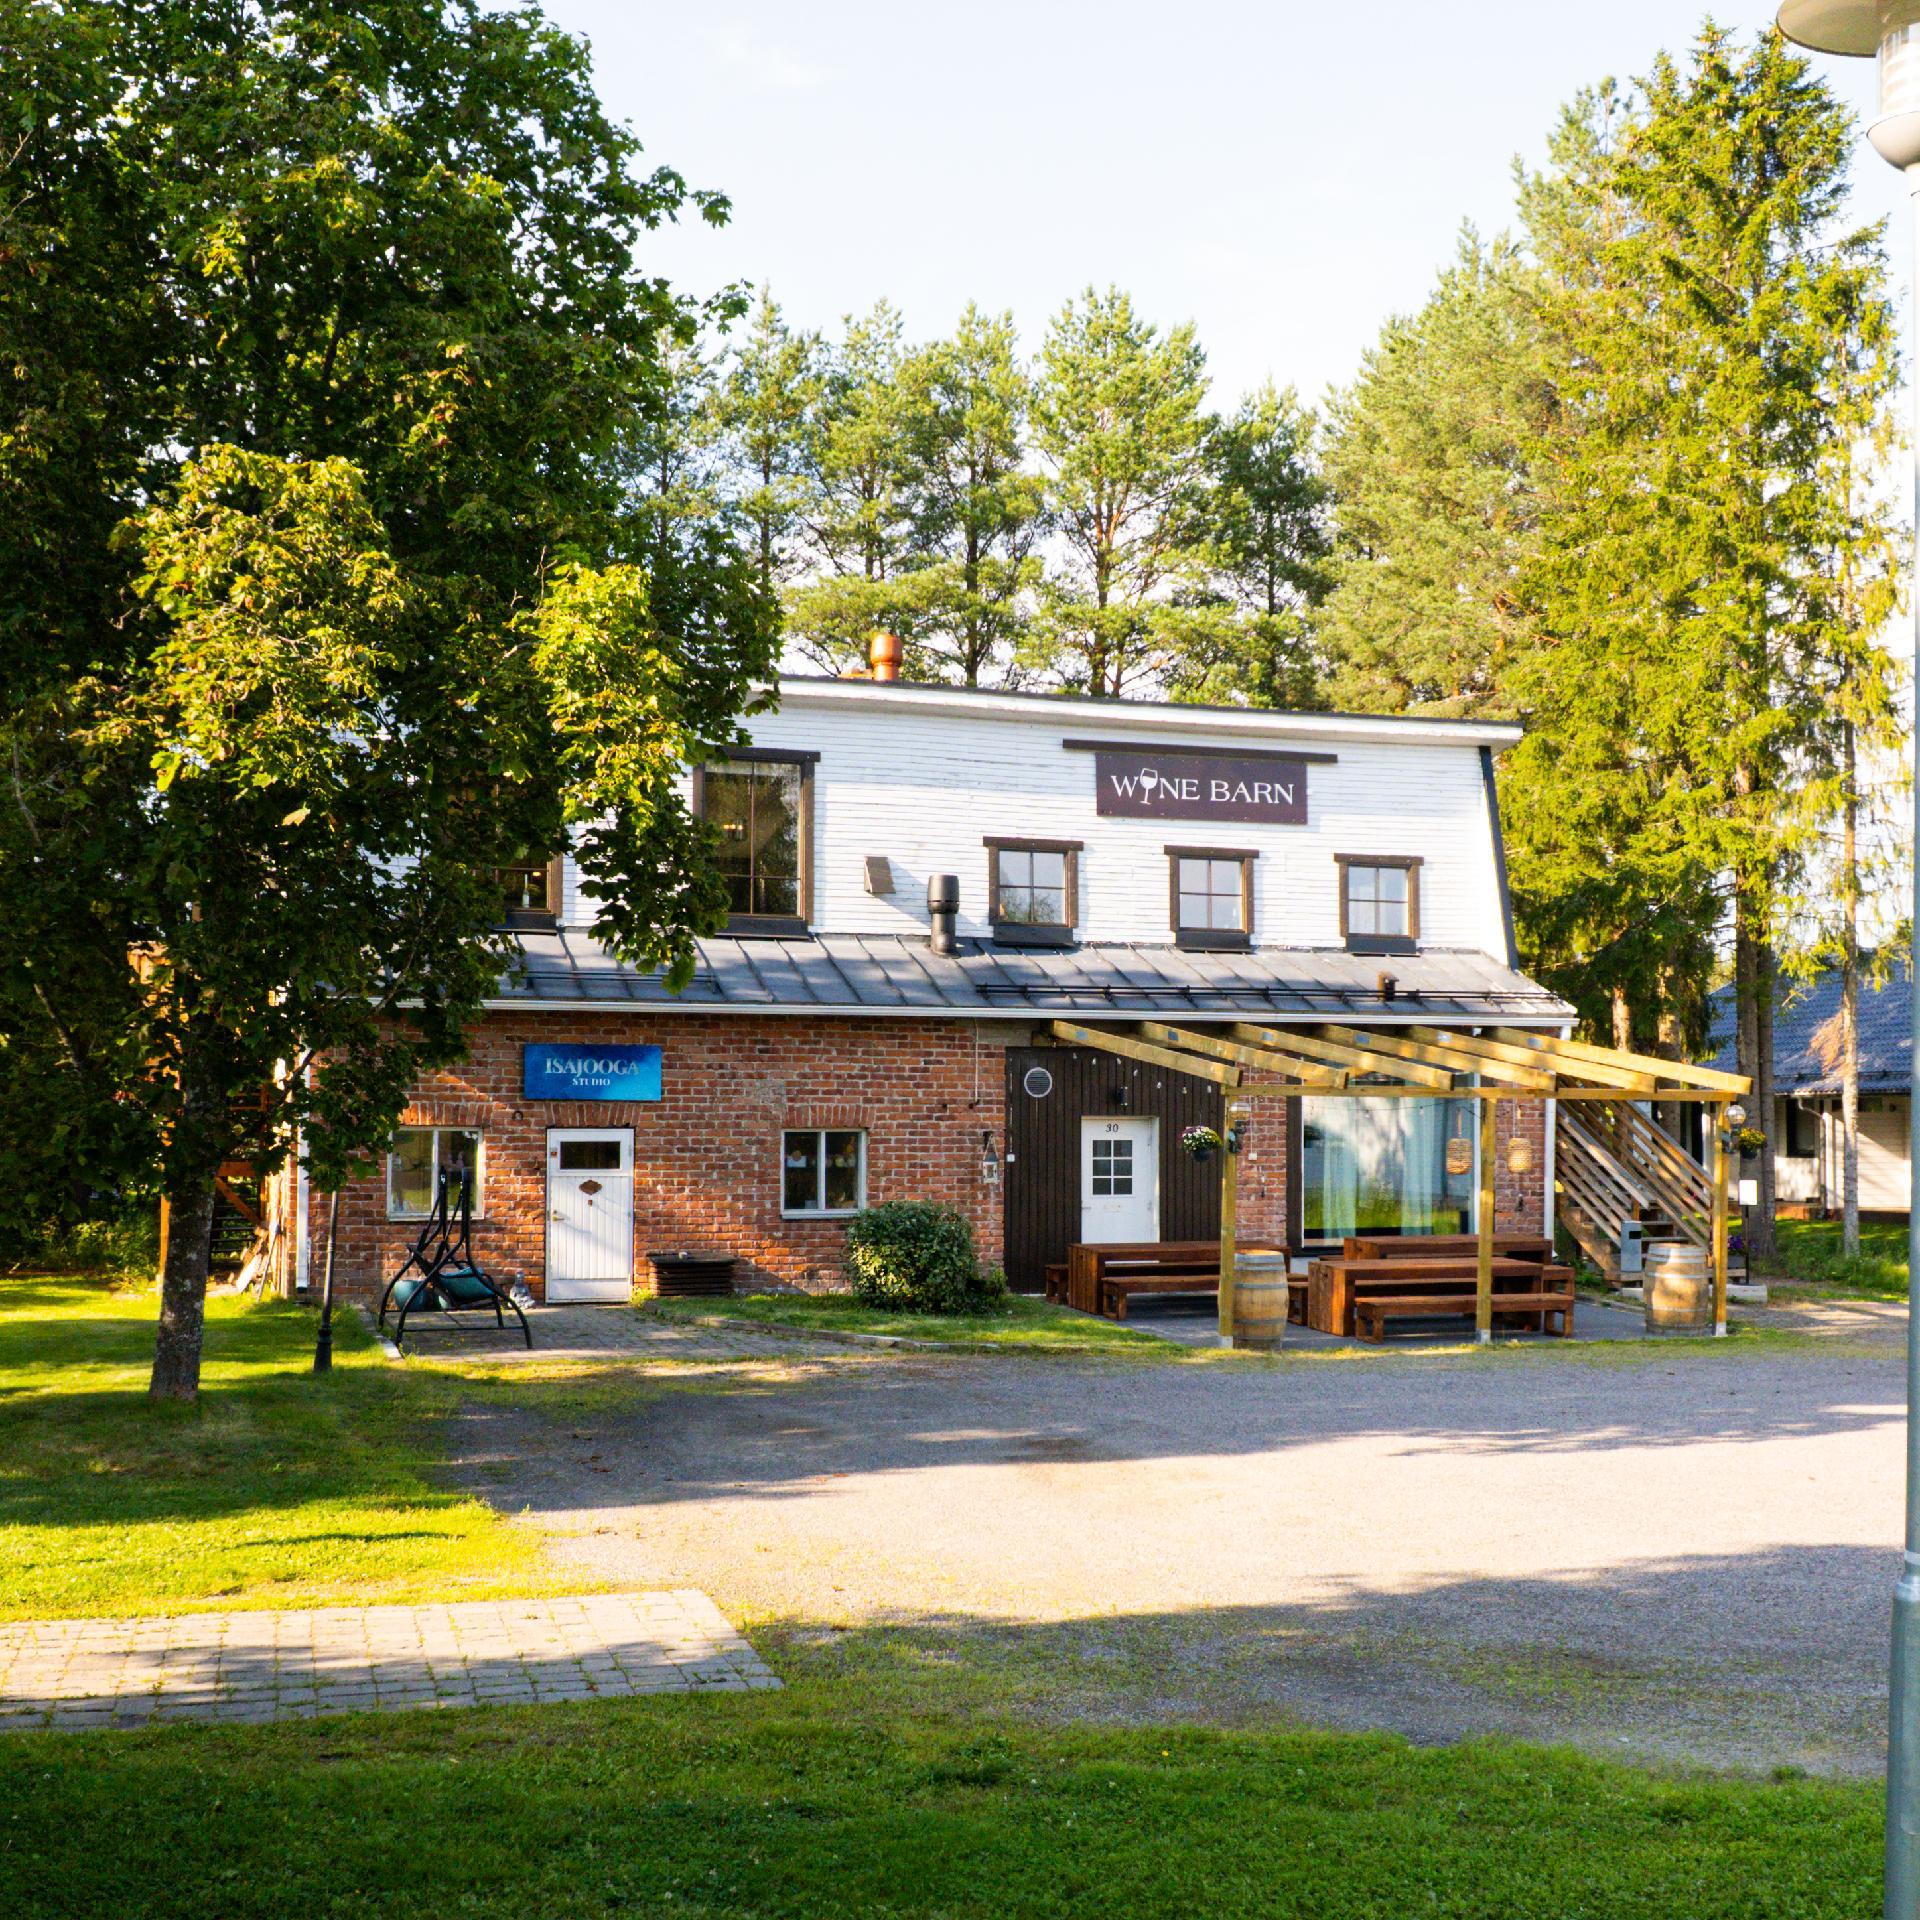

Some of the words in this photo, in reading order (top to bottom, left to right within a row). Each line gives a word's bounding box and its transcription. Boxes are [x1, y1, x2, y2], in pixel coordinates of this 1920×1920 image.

[1111, 767, 1200, 805] WINE
[1210, 779, 1295, 805] BARN
[545, 1058, 640, 1077] ISAJOOGA
[572, 1078, 611, 1087] STUDIO
[1105, 1123, 1119, 1133] 30
